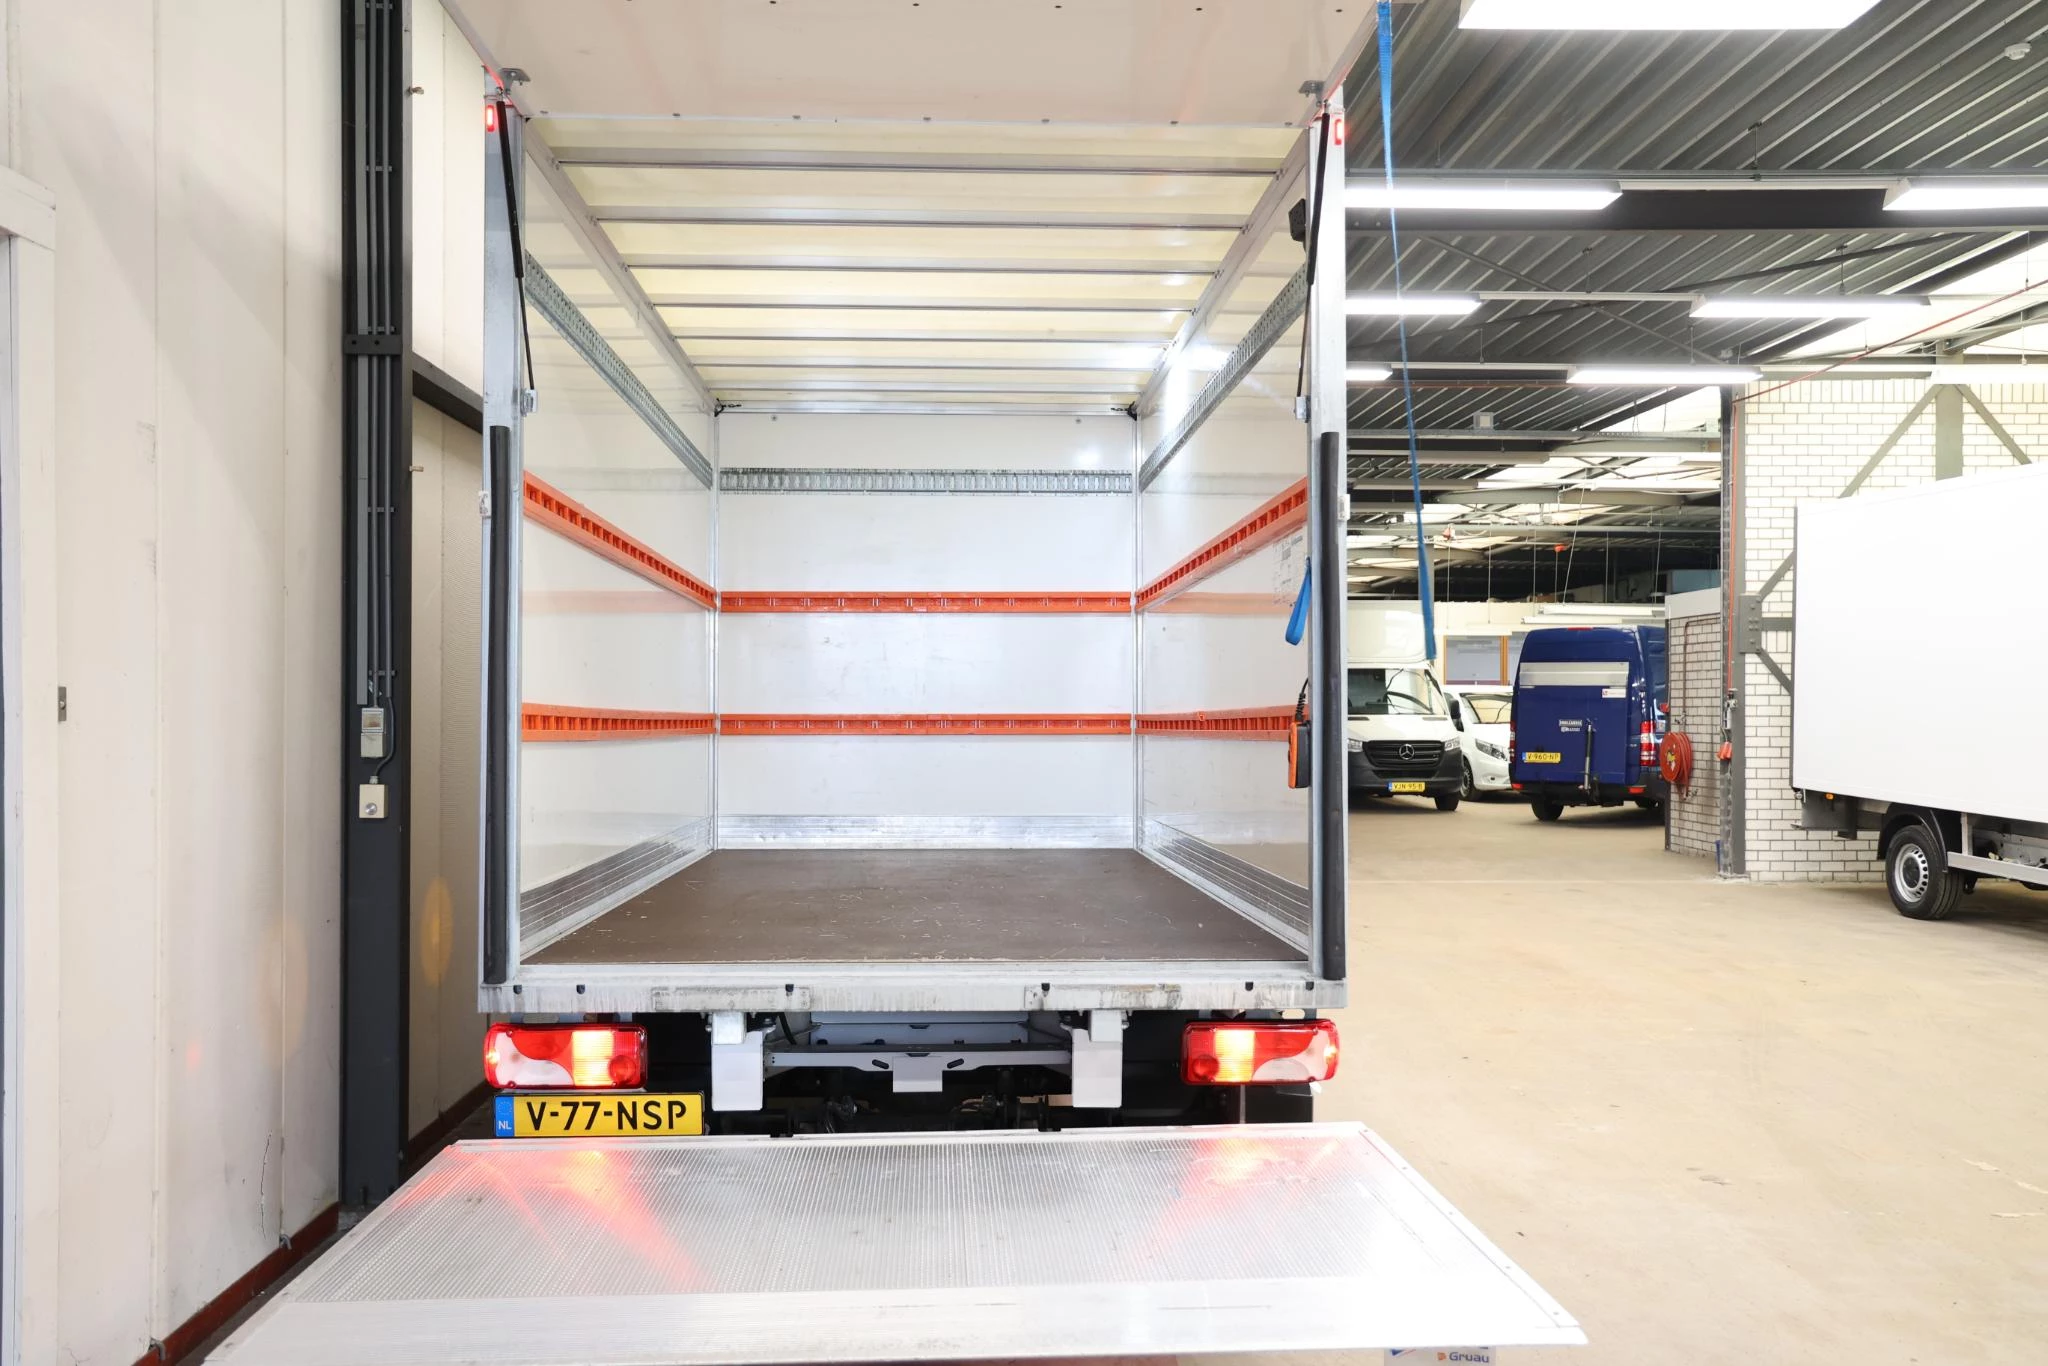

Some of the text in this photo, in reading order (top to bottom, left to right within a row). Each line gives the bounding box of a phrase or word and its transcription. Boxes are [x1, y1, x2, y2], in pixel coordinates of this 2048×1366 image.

[526, 1101, 687, 1131] V-77-NSP
[498, 1121, 512, 1130] NL
[1449, 1351, 1490, 1363] Gruau
